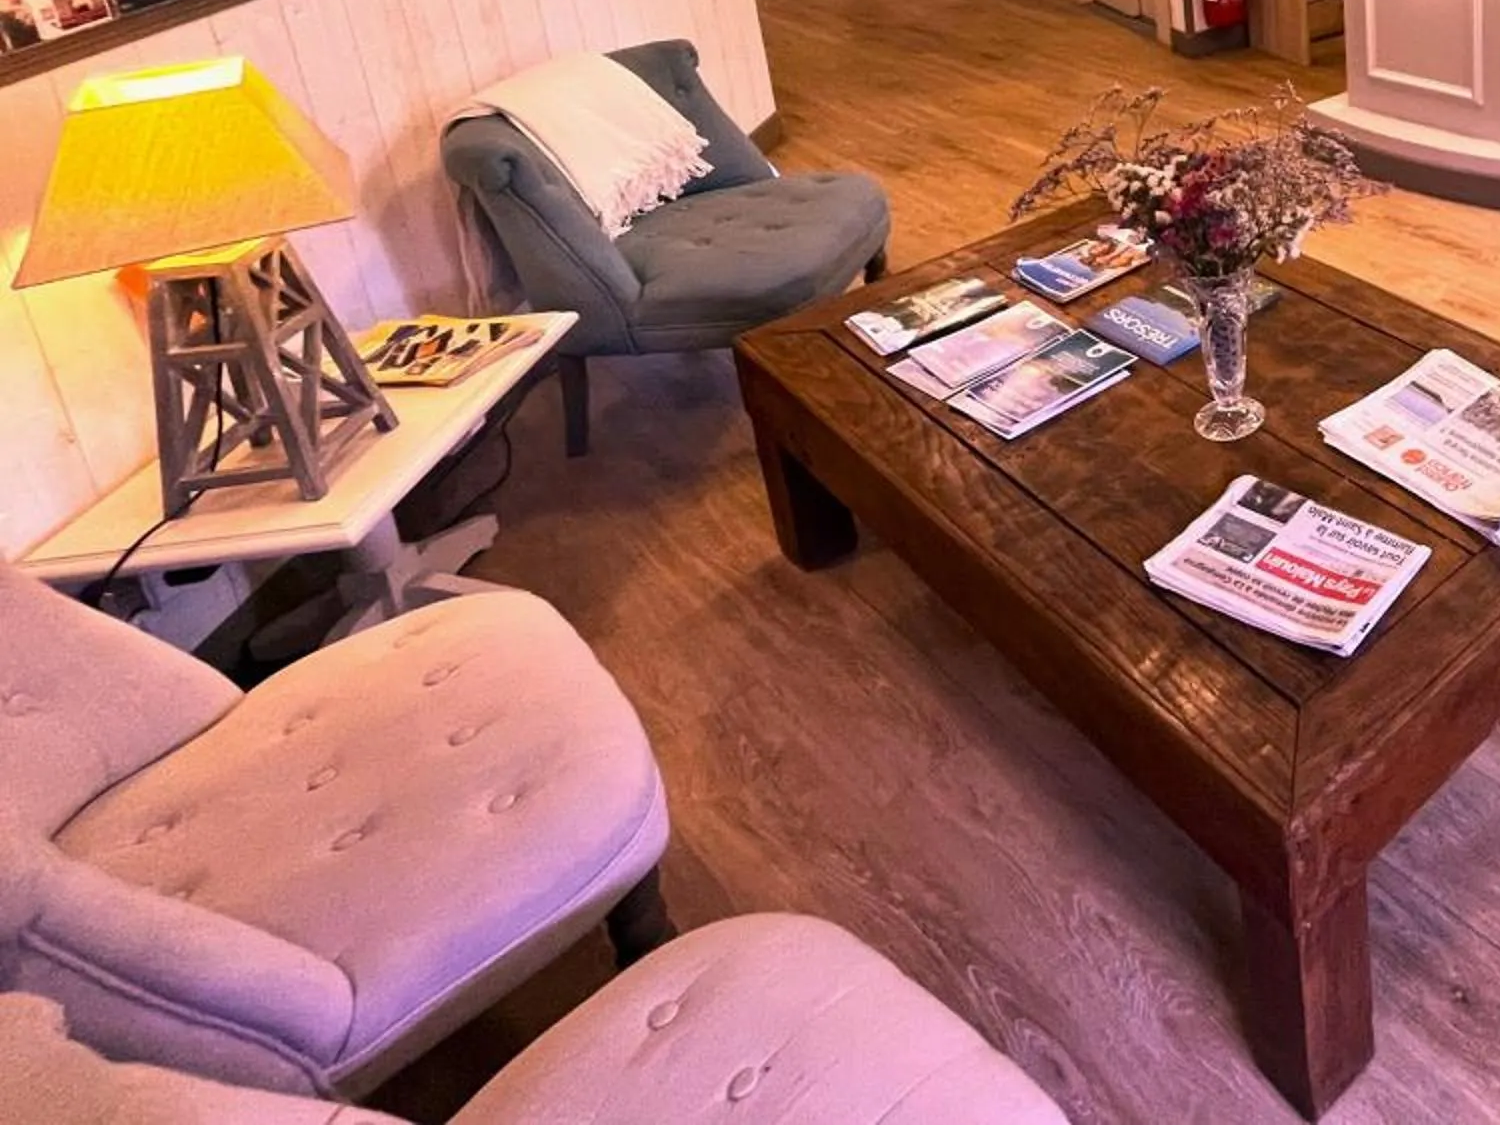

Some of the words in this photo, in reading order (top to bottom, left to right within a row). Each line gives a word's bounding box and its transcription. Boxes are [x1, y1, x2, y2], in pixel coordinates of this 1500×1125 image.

[1104, 308, 1179, 349] TRÉSORS
[1316, 524, 1327, 537] la
[1328, 528, 1346, 542] sur
[1346, 535, 1380, 556] savoir
[1373, 530, 1417, 556] flamme
[1380, 548, 1406, 566] Tout
[1264, 552, 1325, 588] Malouin
[1325, 575, 1362, 598] Pays
